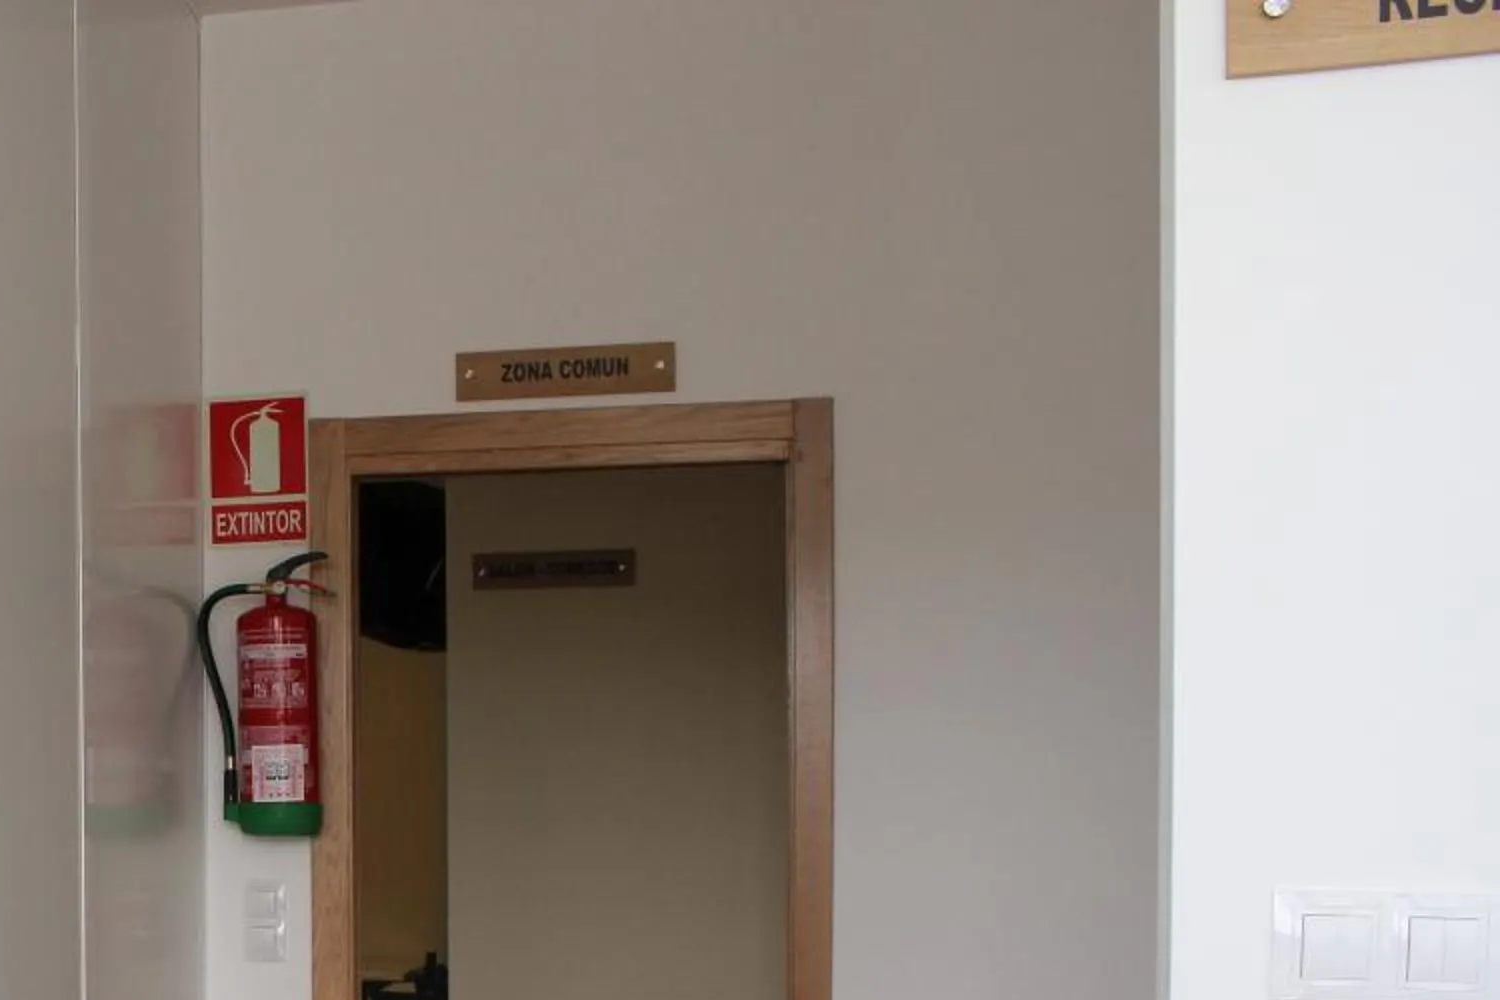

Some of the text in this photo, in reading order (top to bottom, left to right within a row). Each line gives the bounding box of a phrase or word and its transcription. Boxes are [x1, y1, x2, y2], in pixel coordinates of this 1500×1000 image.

[501, 357, 629, 383] ZONA COMUN
[216, 509, 302, 537] EXTINTOR
